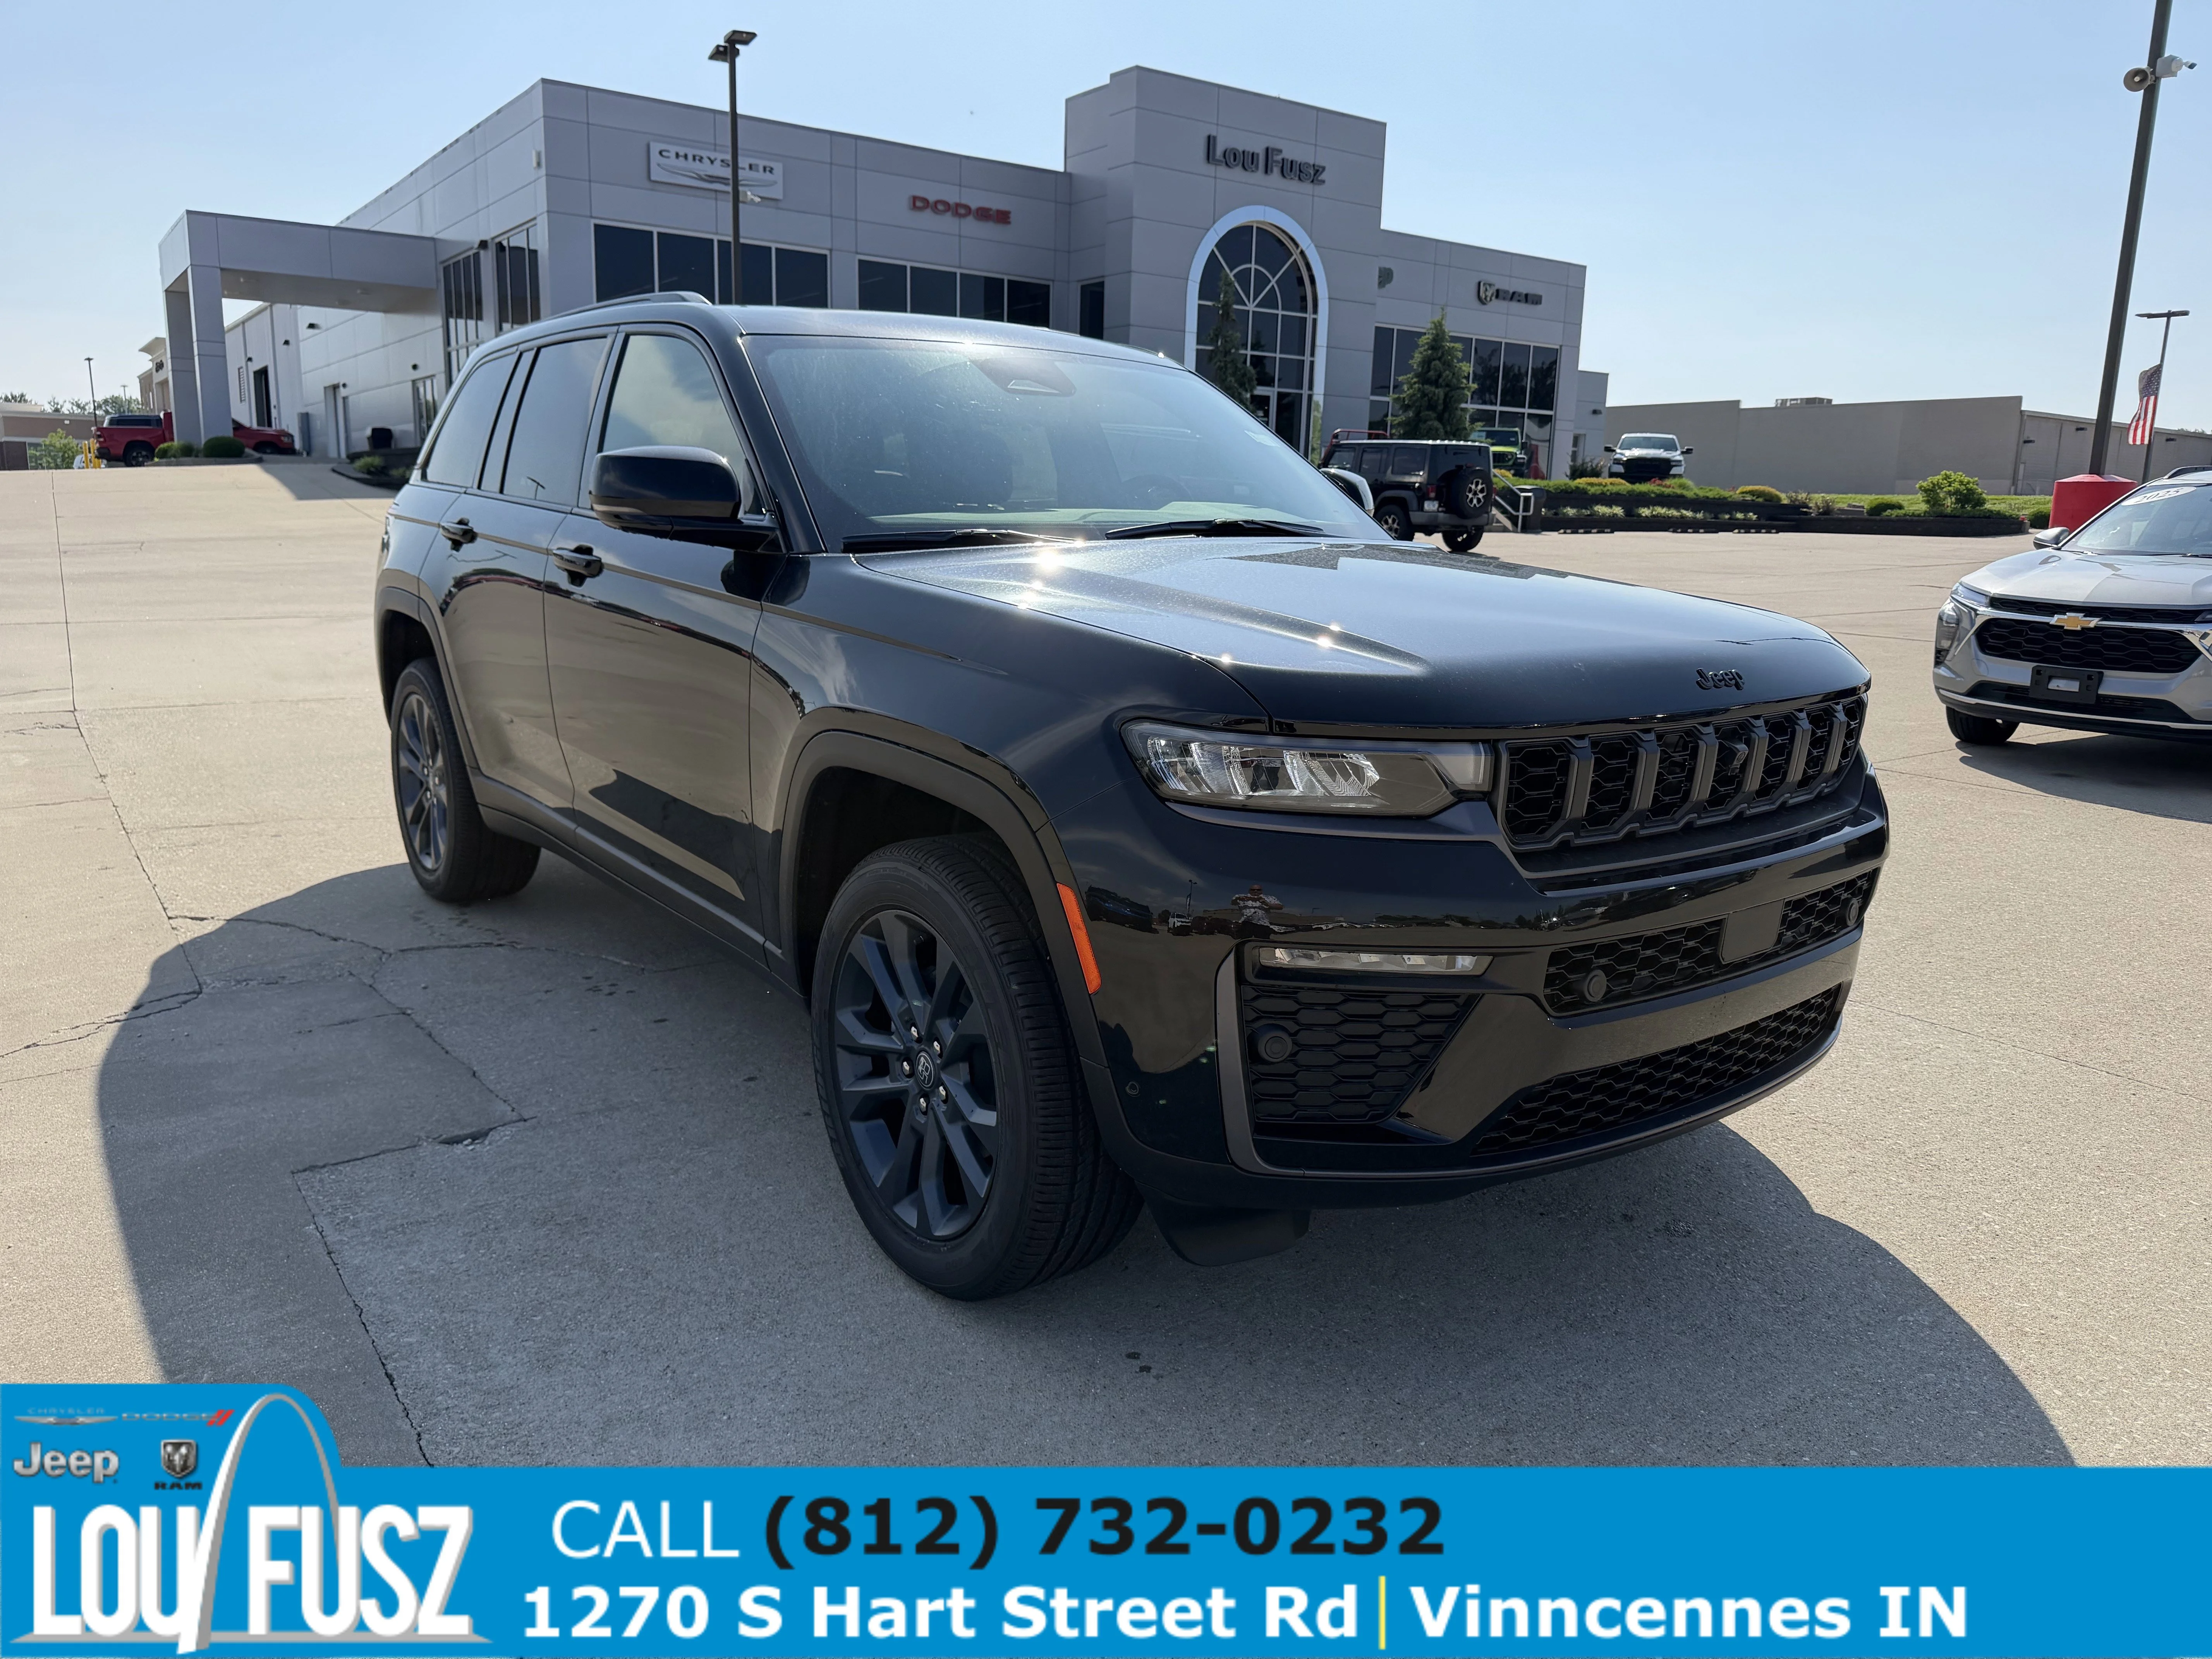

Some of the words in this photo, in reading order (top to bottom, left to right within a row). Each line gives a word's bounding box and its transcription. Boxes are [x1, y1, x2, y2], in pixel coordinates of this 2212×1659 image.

[1207, 134, 1259, 173] Lou
[1264, 146, 1326, 185] Fusz
[910, 195, 1011, 225] DODGE
[1696, 668, 1745, 690] Jeep
